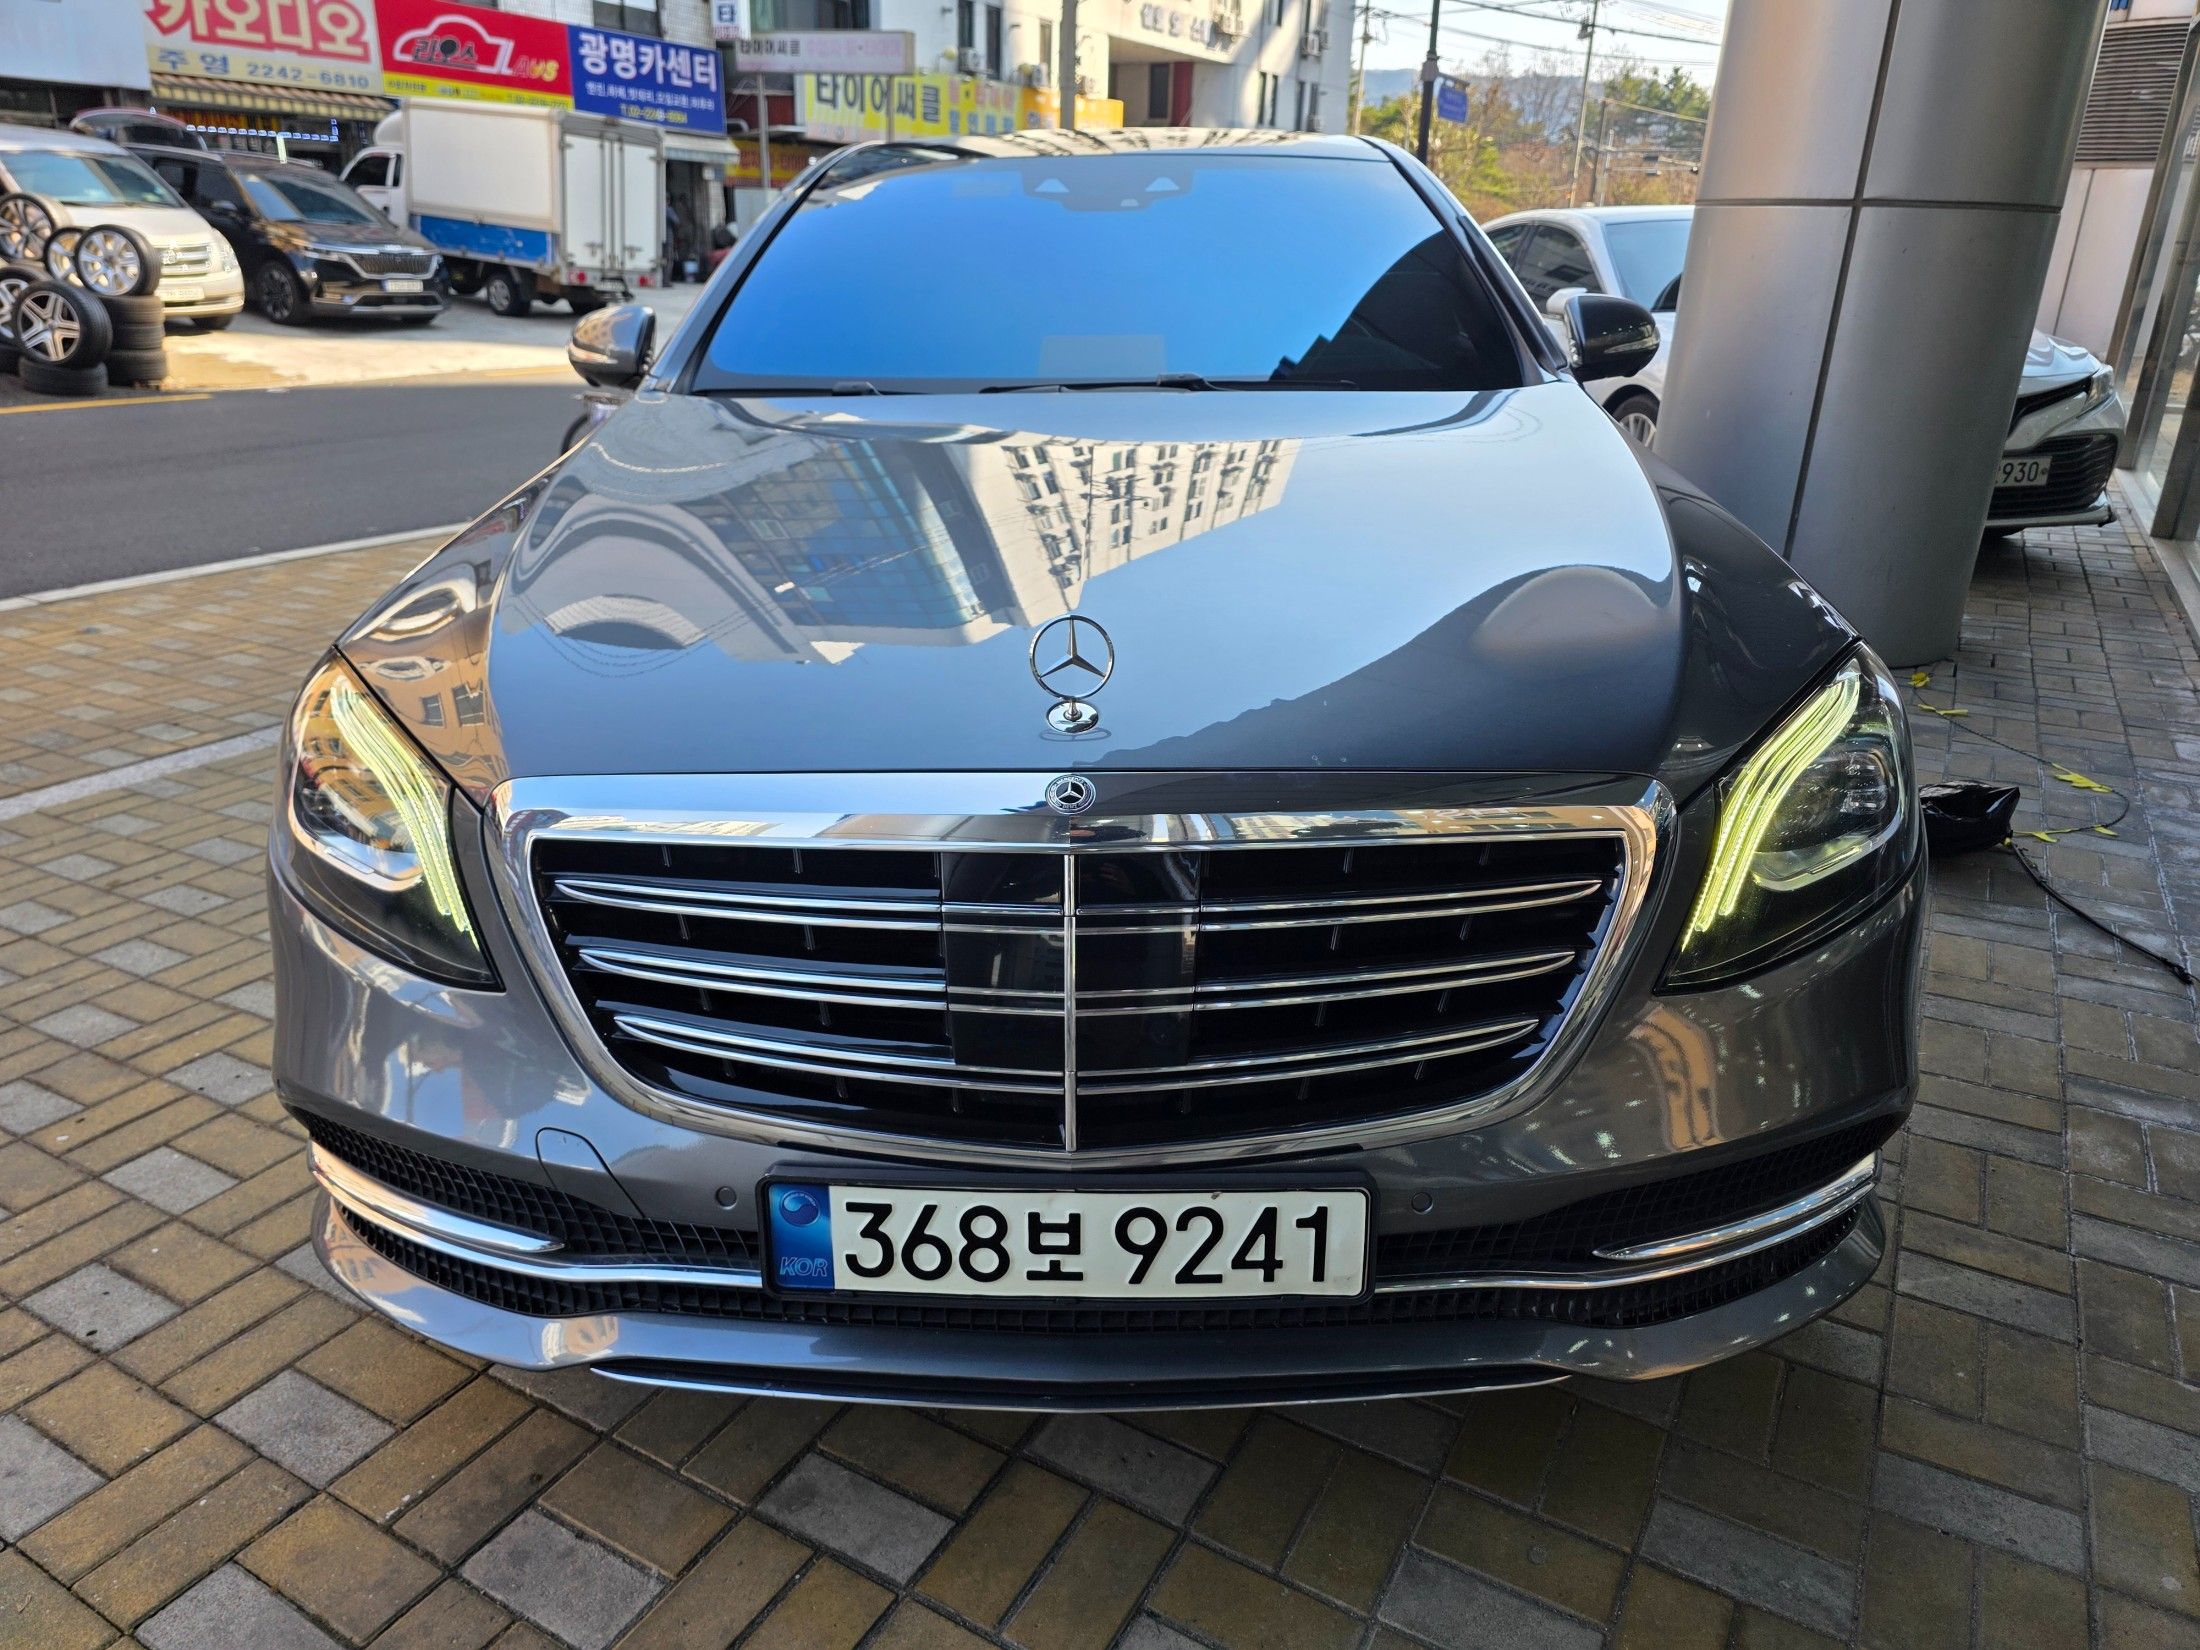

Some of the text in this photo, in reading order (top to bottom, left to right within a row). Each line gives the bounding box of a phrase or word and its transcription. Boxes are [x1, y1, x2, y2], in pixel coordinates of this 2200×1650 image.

[150, 0, 369, 61] 카오디오
[246, 62, 370, 89] 2242-6810
[578, 31, 718, 93] 광명카센터
[1994, 461, 2040, 484] 930
[844, 1200, 1330, 1286] 368보 9241
[780, 1256, 828, 1278] KOR
